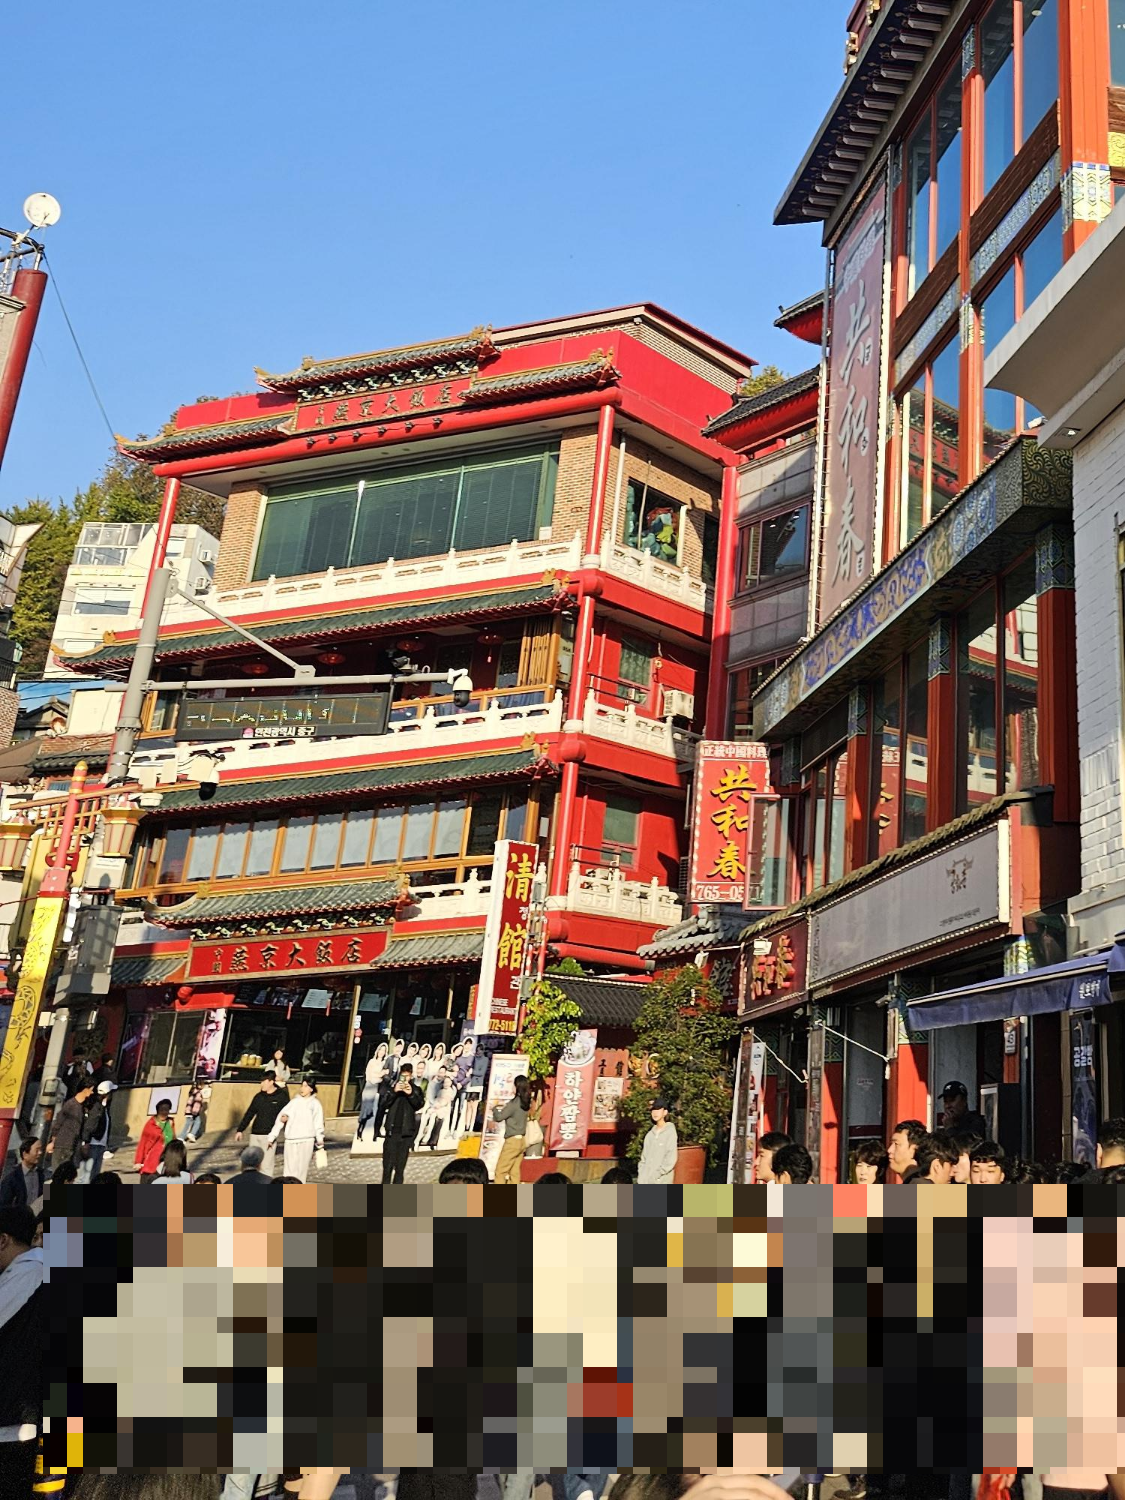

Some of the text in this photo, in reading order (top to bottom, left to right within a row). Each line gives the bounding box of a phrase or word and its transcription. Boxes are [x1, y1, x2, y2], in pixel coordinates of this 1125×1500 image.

[706, 764, 757, 880] 共和春
[558, 1070, 584, 1141] 하얀짬뽕
